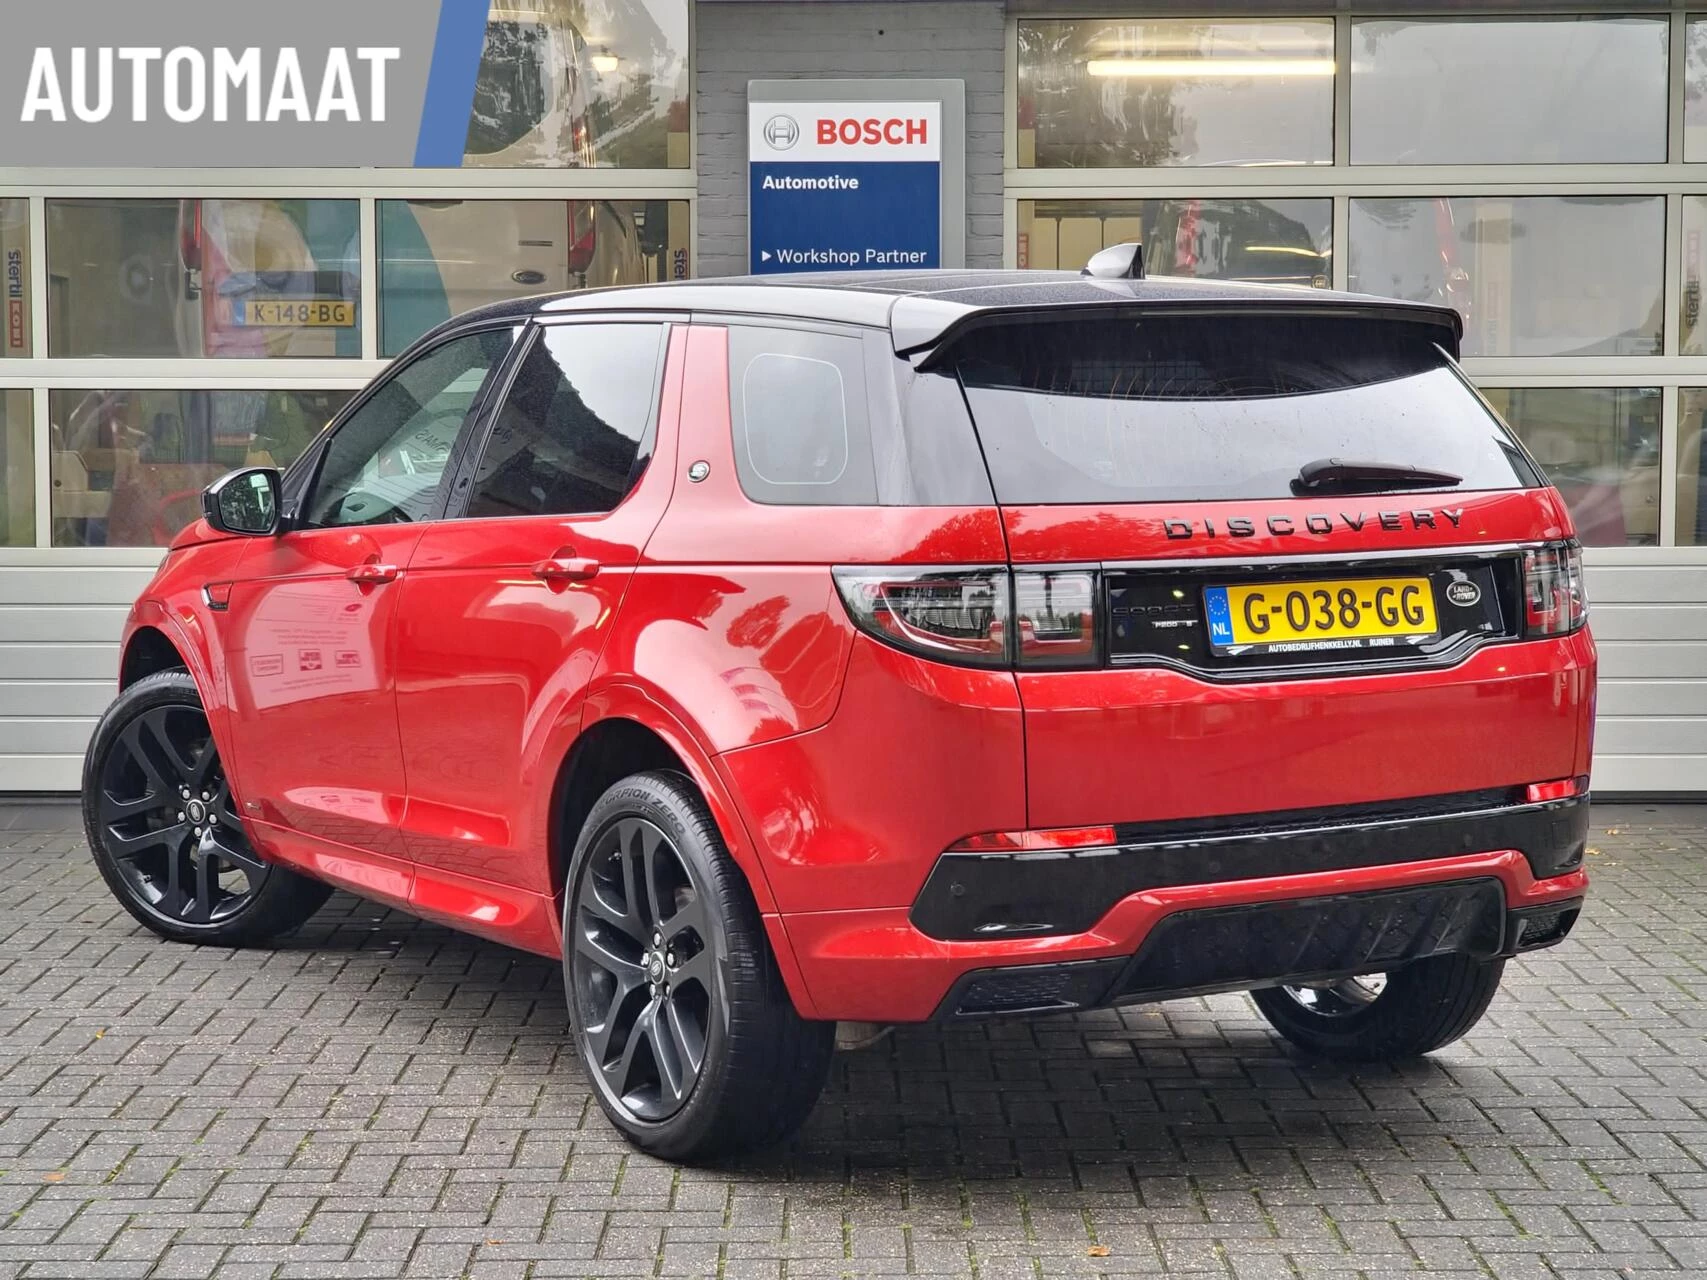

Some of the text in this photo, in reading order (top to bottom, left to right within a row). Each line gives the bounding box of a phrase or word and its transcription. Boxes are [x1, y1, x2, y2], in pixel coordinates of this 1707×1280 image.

[816, 118, 927, 145] BOSCH
[762, 175, 860, 190] Automotive
[776, 249, 928, 266] Workshop Partner
[254, 303, 346, 322] K-148-BG
[1163, 507, 1465, 540] DISCOVERY
[1243, 585, 1425, 634] G-038-GG
[1213, 623, 1230, 636] NL
[651, 798, 686, 835] ZERO
